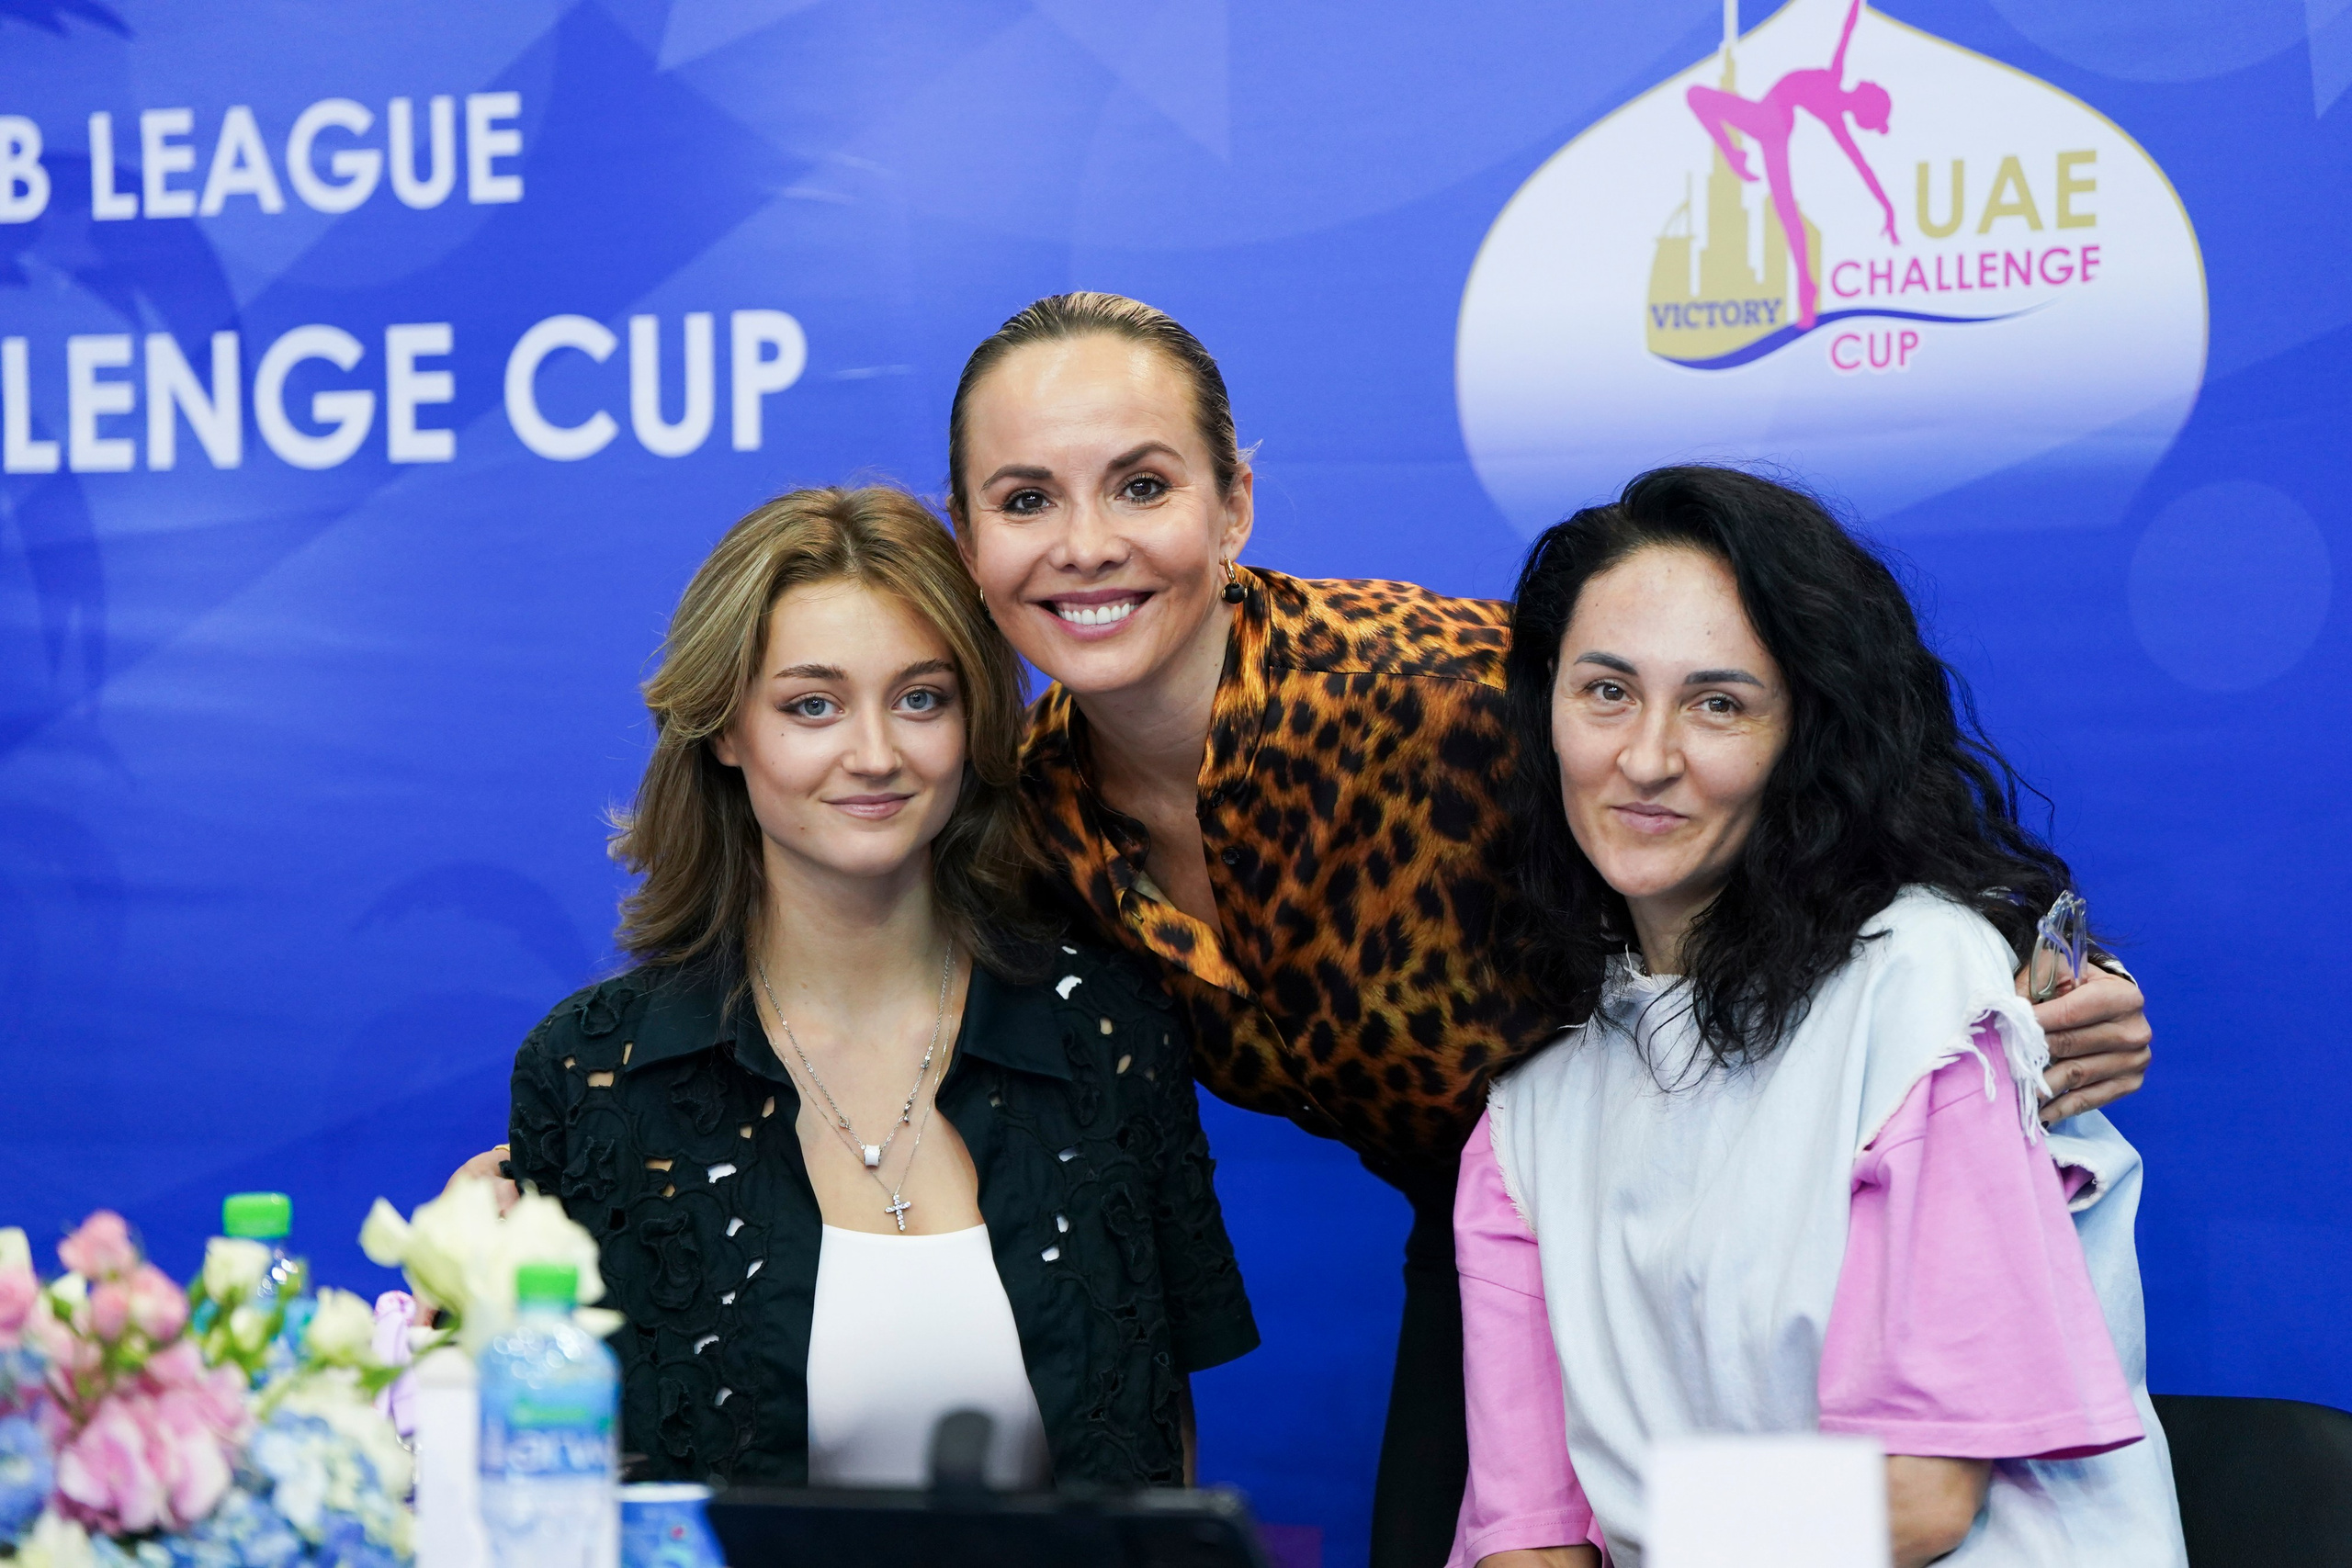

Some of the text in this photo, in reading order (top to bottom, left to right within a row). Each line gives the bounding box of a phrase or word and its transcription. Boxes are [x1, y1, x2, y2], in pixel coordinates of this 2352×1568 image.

[0, 92, 524, 223] B LEAGUE
[1916, 149, 2098, 239] UAE
[1831, 245, 2101, 299] CHALLENGE
[1650, 299, 1782, 330] VICTORY
[1830, 330, 1920, 370] CUP
[2, 309, 808, 472] LENGE CUP
